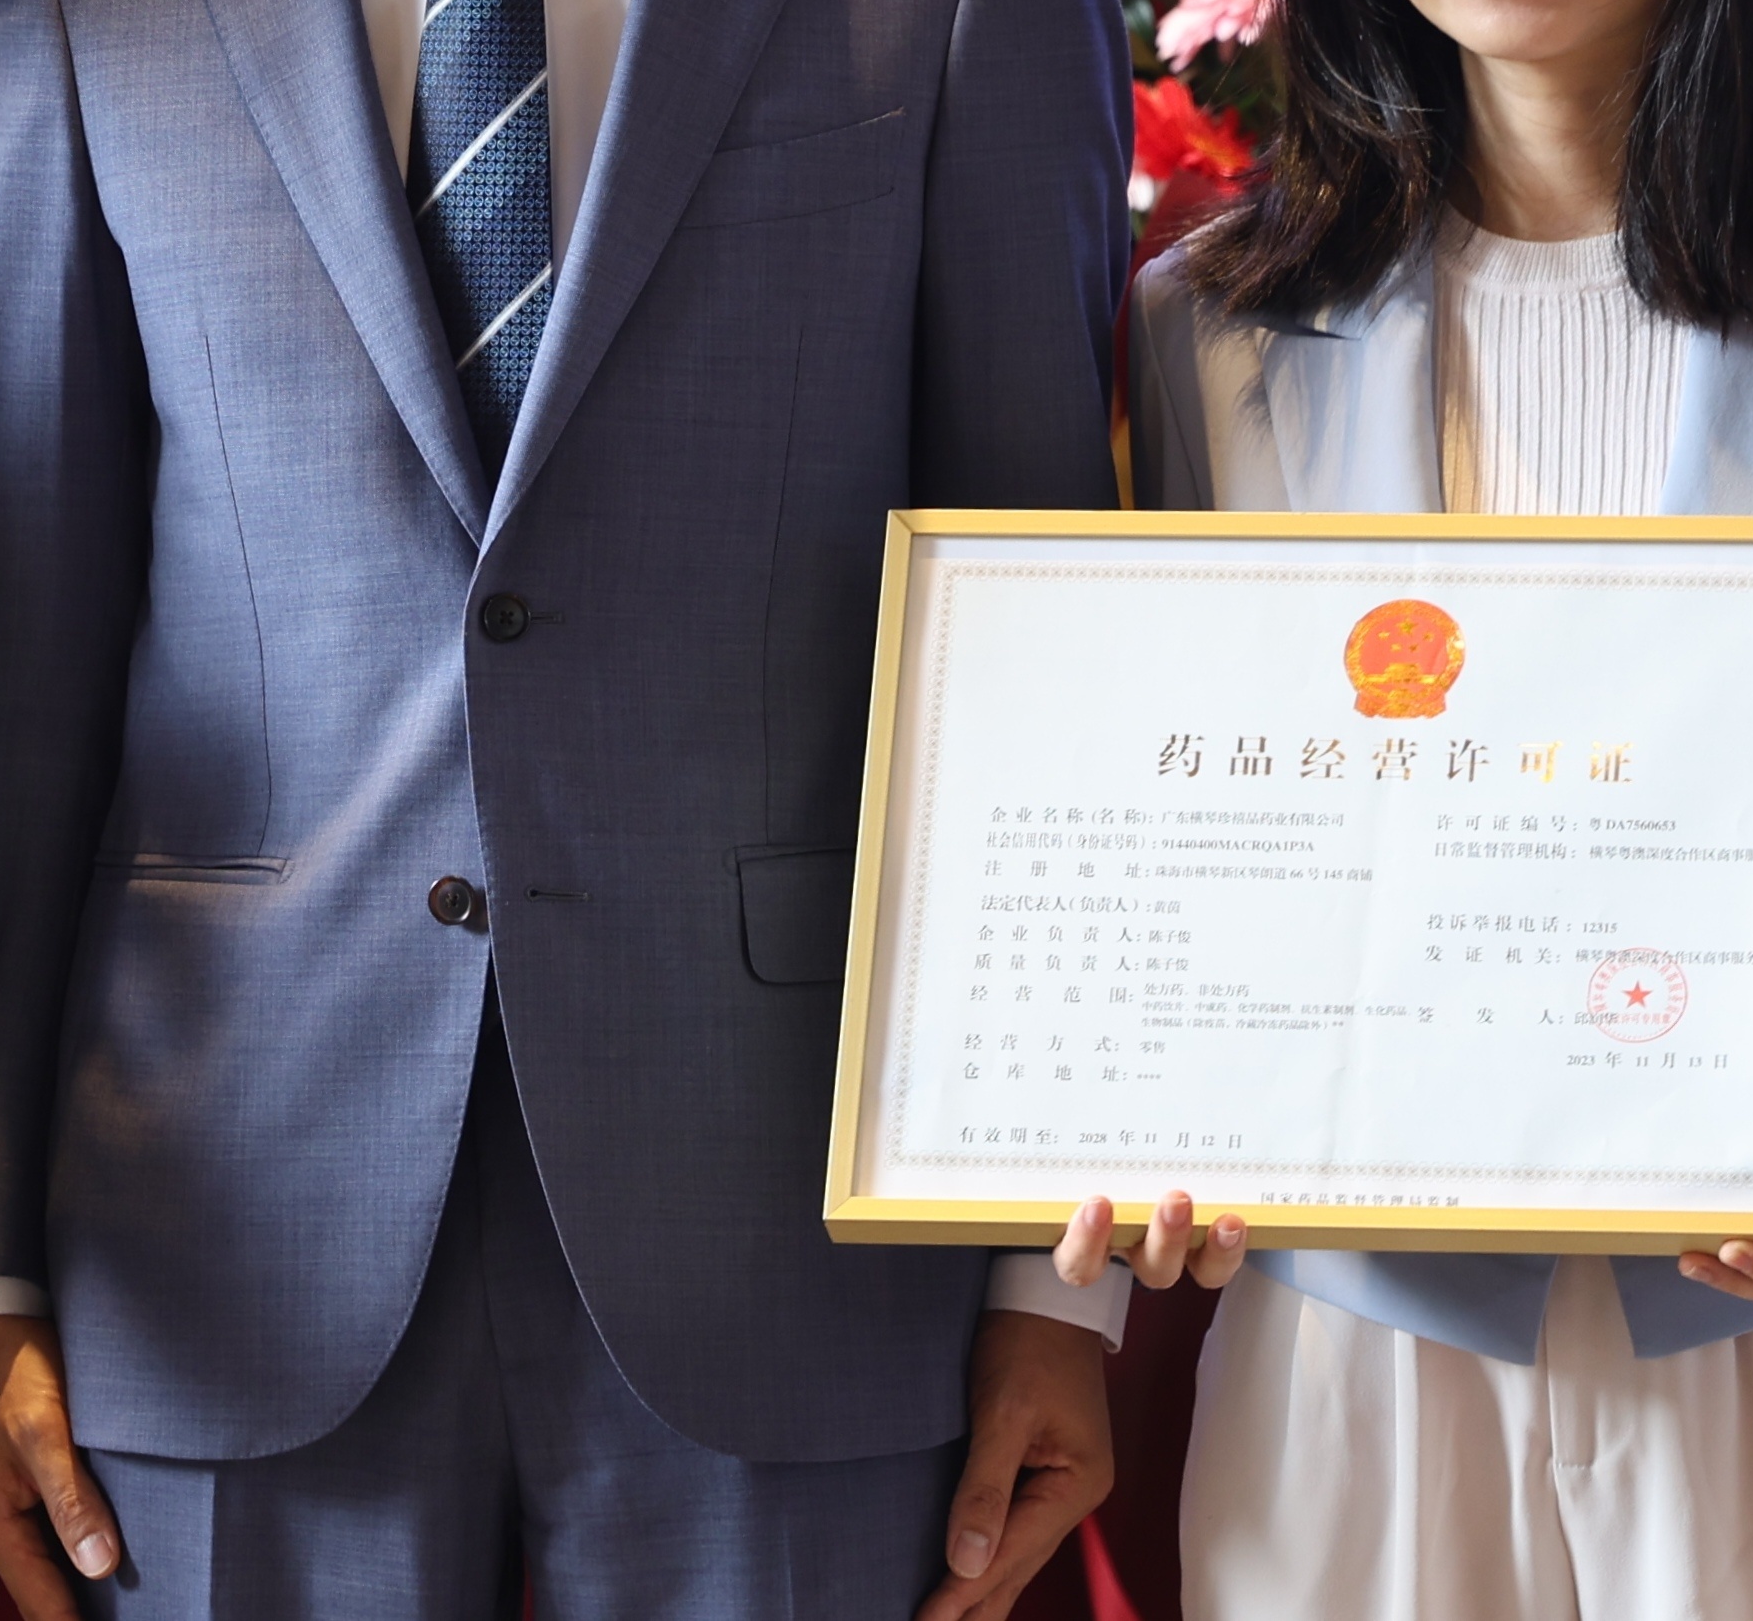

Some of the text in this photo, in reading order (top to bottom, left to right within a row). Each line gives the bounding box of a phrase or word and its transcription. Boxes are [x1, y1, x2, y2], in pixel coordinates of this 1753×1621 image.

[1156, 733, 1635, 785] 药品经营许可证
[1582, 921, 1618, 934] 12315
